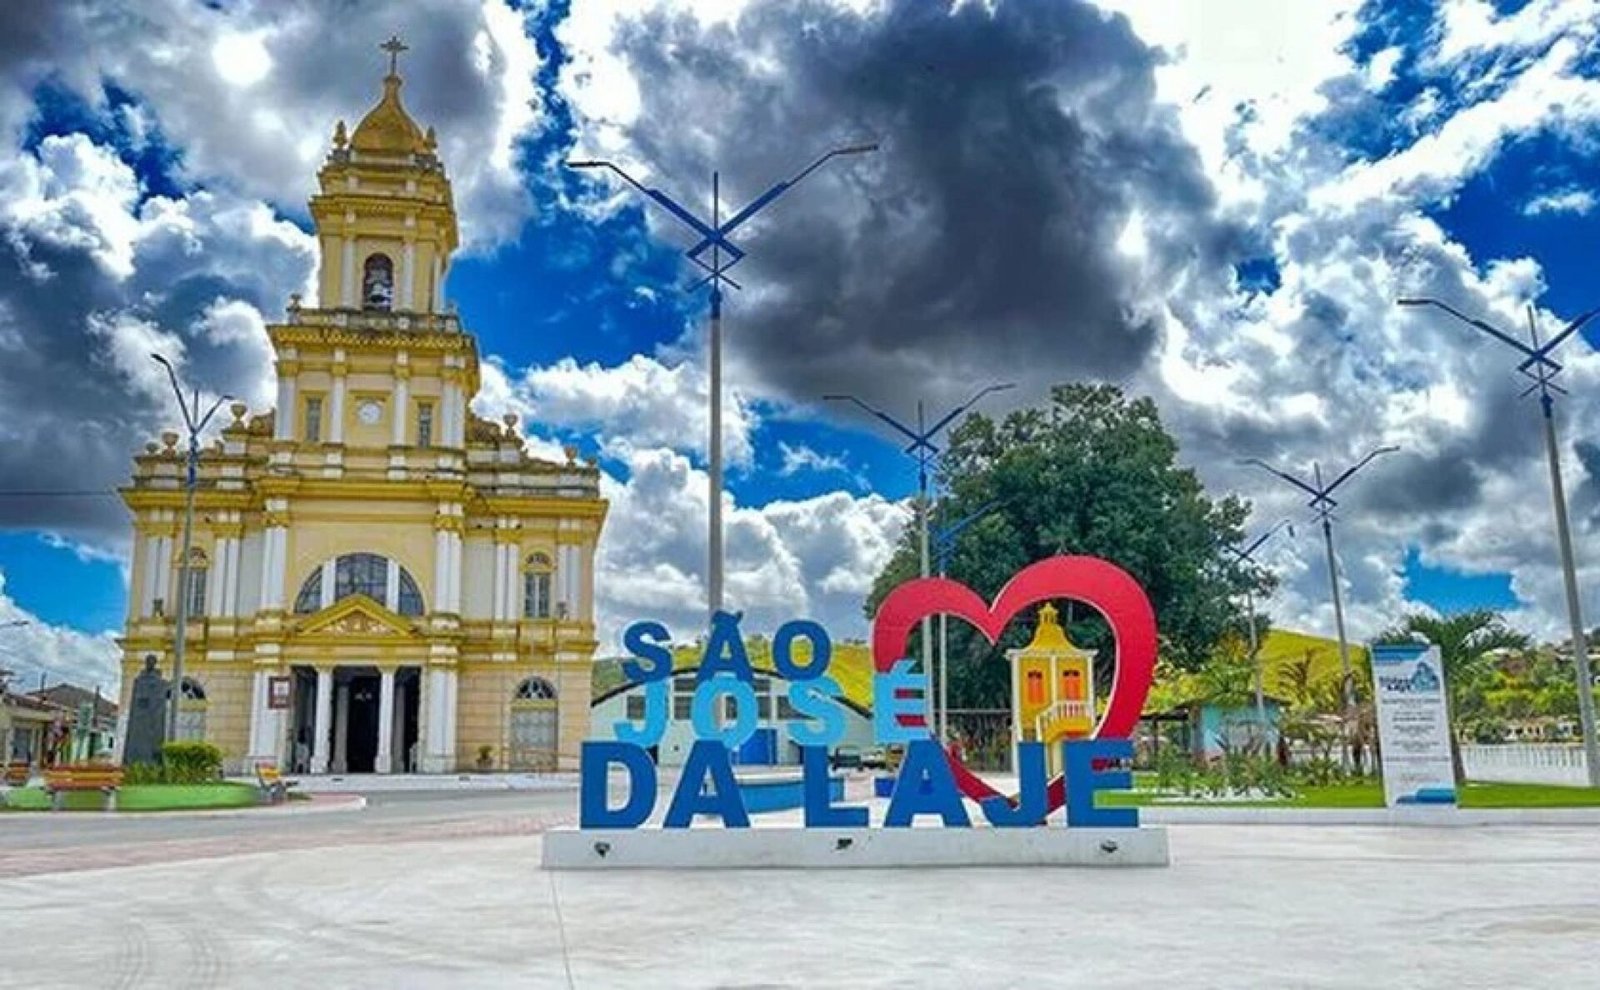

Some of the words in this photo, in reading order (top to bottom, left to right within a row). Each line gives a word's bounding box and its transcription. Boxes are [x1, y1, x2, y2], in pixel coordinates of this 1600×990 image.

[622, 610, 832, 683] SÃO
[613, 658, 929, 750] JOSÉ
[580, 740, 751, 829] DA
[803, 740, 1139, 829] LAJE
